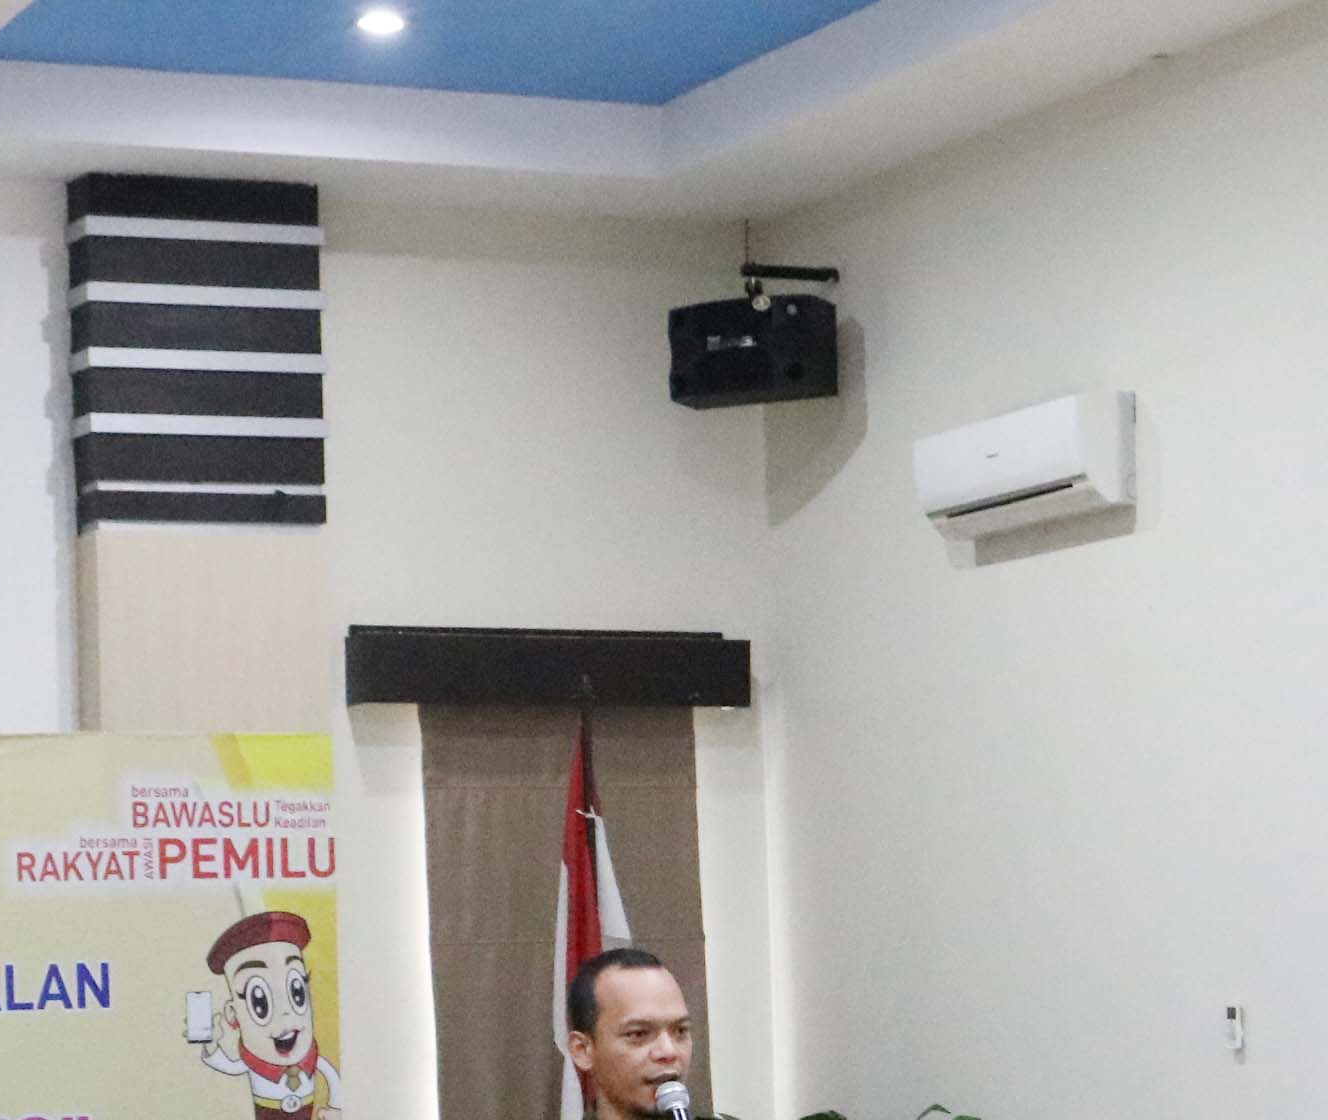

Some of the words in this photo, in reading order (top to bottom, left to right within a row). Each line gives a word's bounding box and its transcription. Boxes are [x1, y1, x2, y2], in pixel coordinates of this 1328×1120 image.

[131, 786, 189, 798] bersama
[275, 800, 331, 814] Tegakkan
[132, 800, 270, 828] BAWASLU
[274, 817, 326, 829] Keadilan
[79, 836, 138, 849] bersama
[16, 850, 141, 882] RAKYAT
[158, 837, 336, 880] PEMILU
